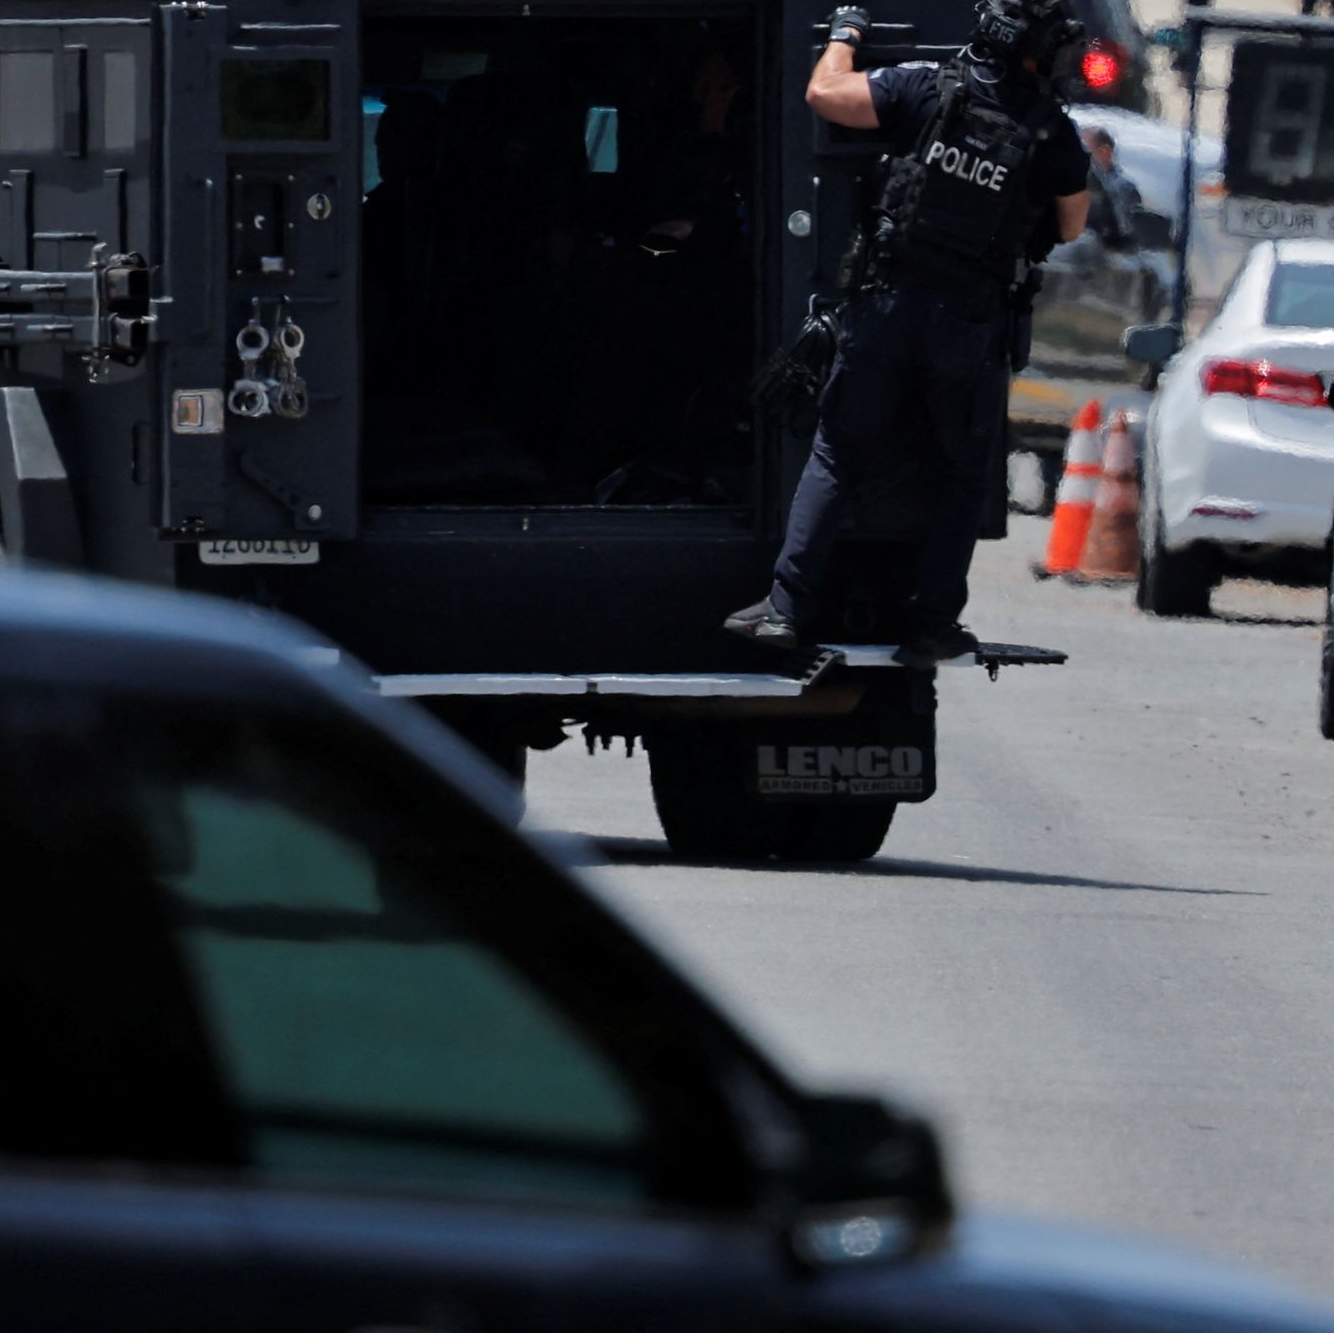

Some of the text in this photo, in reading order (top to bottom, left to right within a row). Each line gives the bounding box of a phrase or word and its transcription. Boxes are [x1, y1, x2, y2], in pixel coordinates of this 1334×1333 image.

[925, 140, 1008, 192] POLICE
[1242, 205, 1315, 232] YOUR
[757, 745, 923, 777] LENCO
[762, 778, 923, 793] ARMORED VEHICLES
